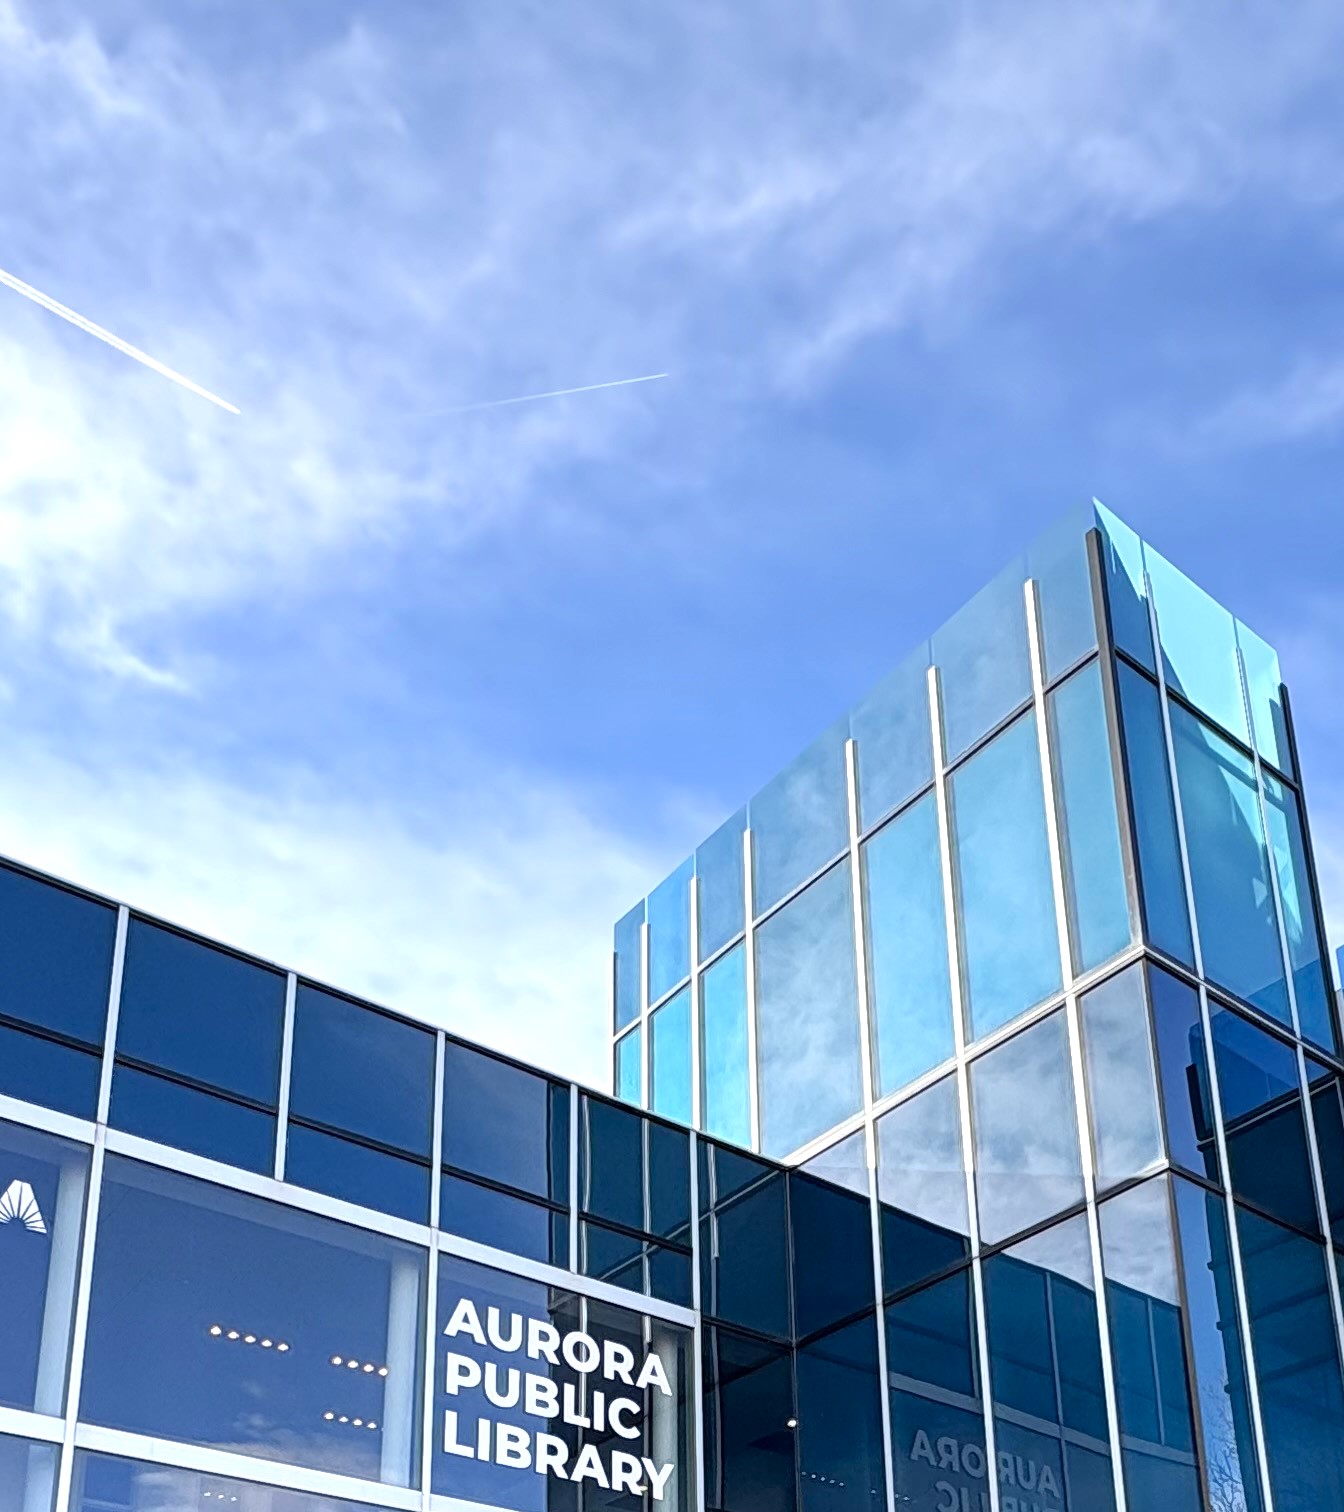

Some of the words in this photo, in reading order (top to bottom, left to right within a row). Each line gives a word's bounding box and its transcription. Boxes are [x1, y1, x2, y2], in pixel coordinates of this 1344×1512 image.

[443, 1298, 672, 1397] AURORA
[445, 1351, 641, 1439] PUBLIC
[444, 1409, 674, 1500] LIBRARY
